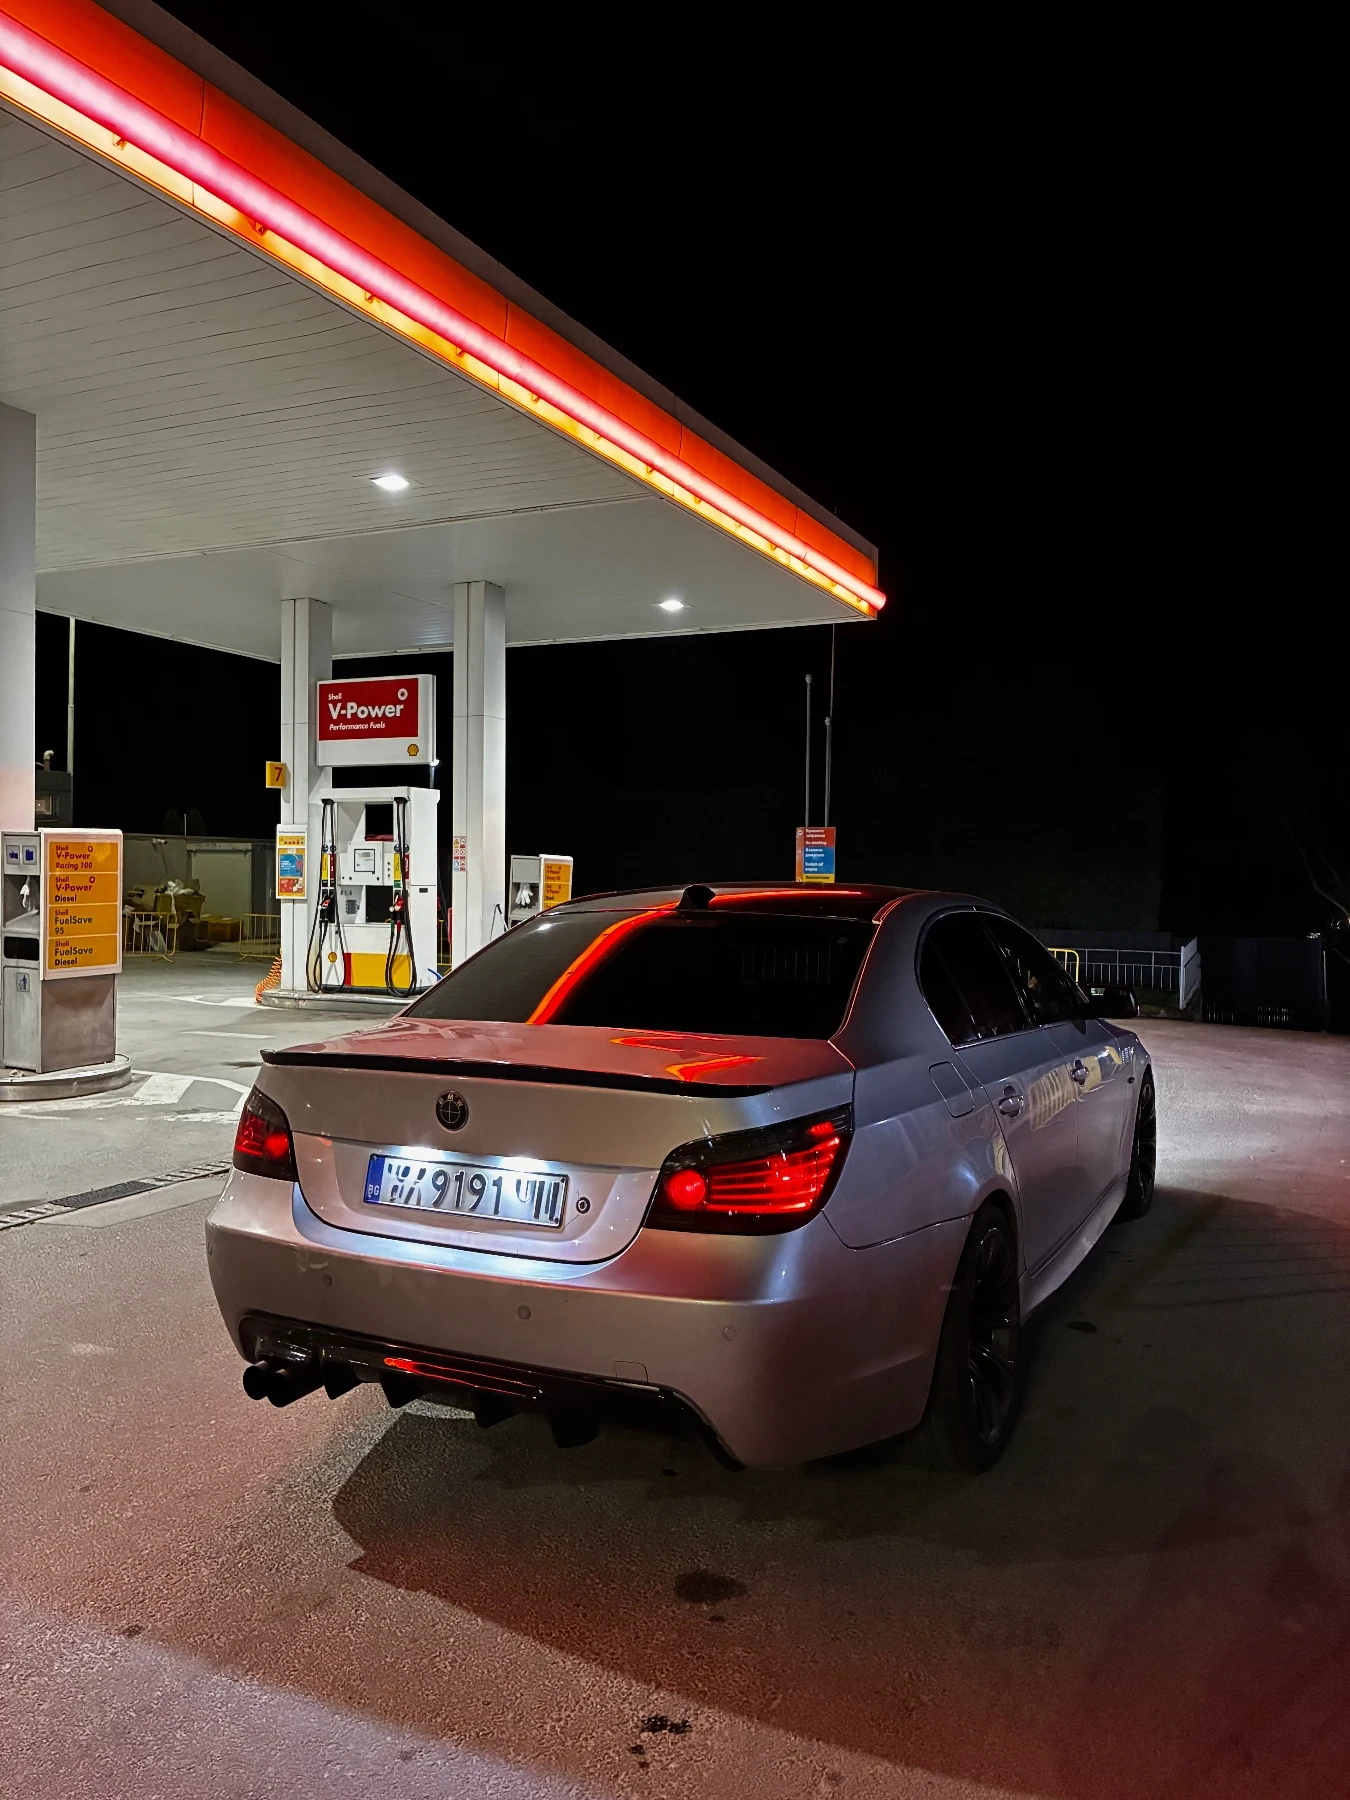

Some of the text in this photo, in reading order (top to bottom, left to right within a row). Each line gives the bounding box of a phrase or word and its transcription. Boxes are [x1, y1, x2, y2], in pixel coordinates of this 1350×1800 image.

[328, 702, 404, 720] V-Power
[329, 721, 386, 731] Performance Fuels
[274, 766, 283, 782] 7
[55, 852, 91, 860] V-Power
[55, 862, 79, 871] Racing
[55, 884, 93, 892] V-Power
[54, 916, 93, 925] FuelSave
[54, 927, 65, 935] 95
[54, 947, 94, 957] FuelSave
[54, 958, 78, 966] Diesel
[367, 1184, 380, 1196] BG
[431, 1168, 503, 1216] 9191
